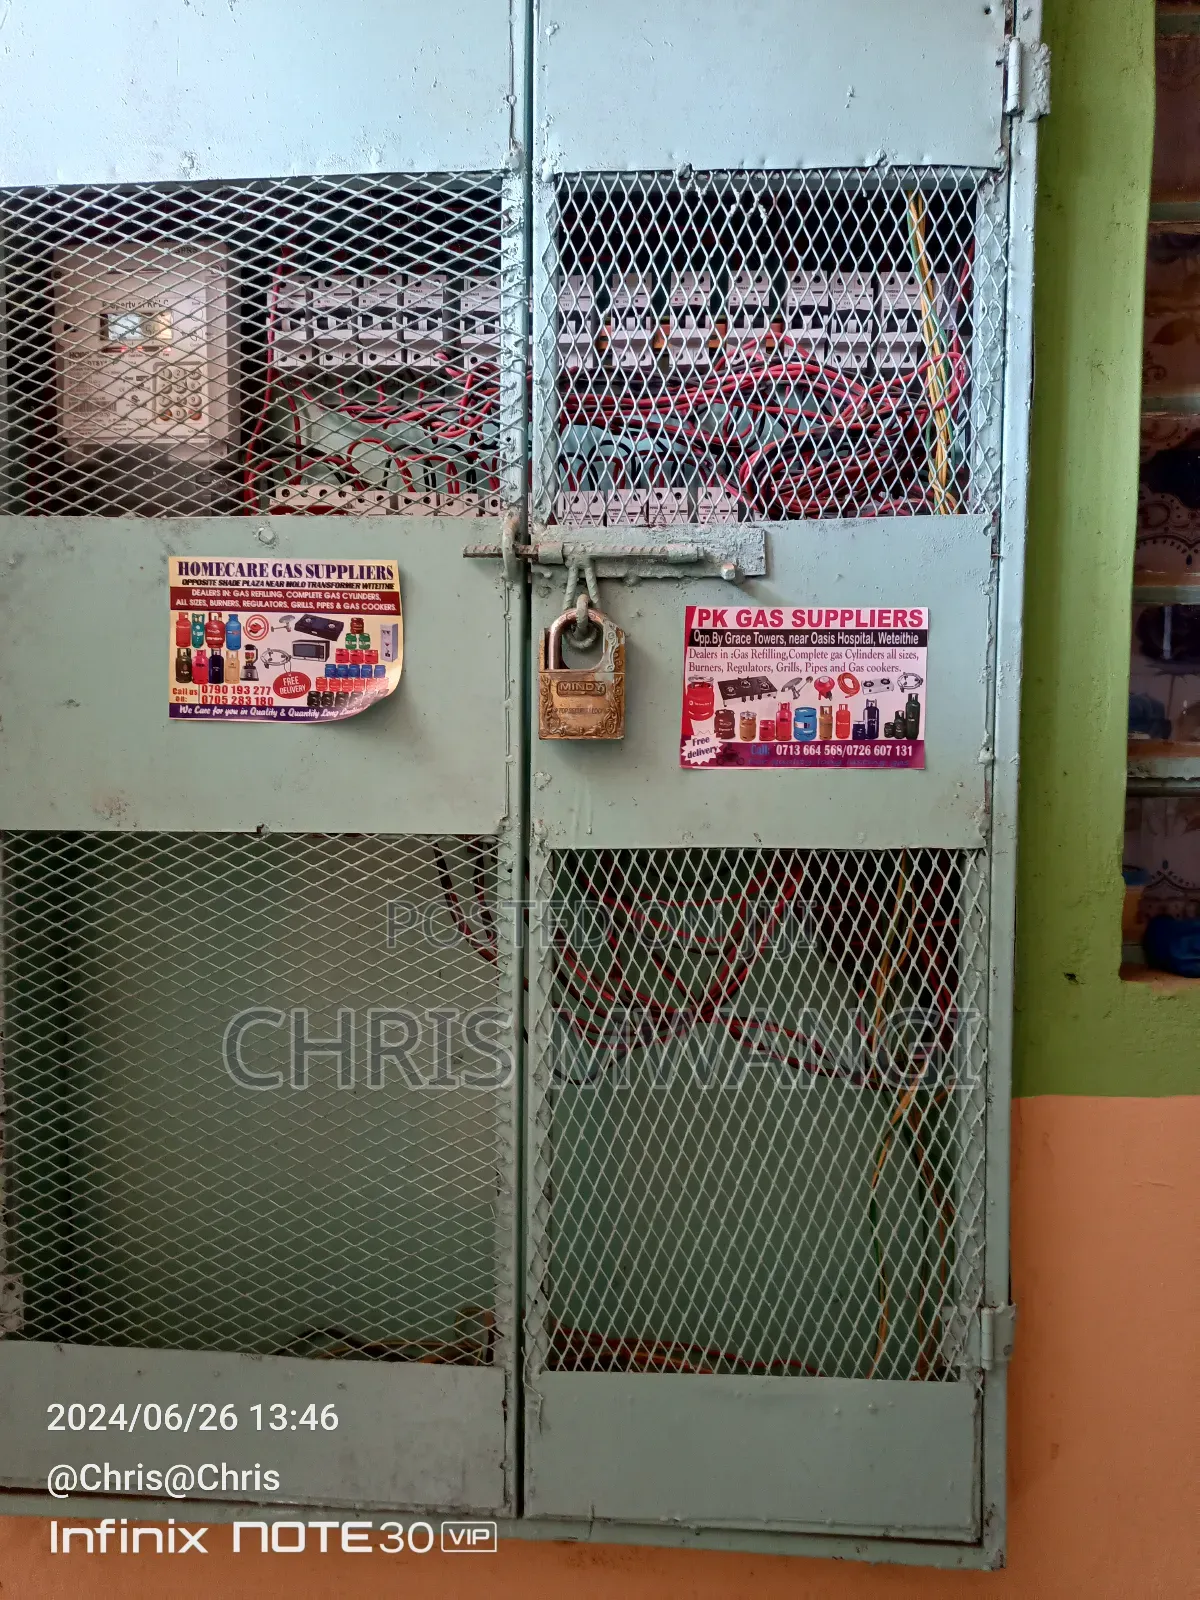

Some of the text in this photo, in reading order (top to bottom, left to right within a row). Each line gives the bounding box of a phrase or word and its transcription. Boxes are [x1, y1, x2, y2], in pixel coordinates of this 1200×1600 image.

[178, 561, 394, 581] HOMECARE GAS SUPPLIERS
[219, 579, 241, 587] SHADE
[265, 580, 284, 588] NEAR
[192, 589, 221, 597] DEALERS
[286, 591, 323, 599] COMPLETE
[342, 592, 382, 601] CYLINDERS,
[698, 609, 924, 628] PK GAS SUPPLIERS
[725, 632, 751, 645] Grace
[753, 632, 787, 646] Towers,
[788, 634, 808, 645] near
[810, 632, 836, 645] Oasis
[837, 631, 876, 647] Hospital,
[878, 632, 919, 645] Weteithie
[689, 649, 718, 659] Dealers
[720, 649, 729, 659] in
[830, 651, 843, 661] gas
[845, 649, 885, 661] Cylinders
[886, 649, 897, 660] all
[898, 650, 919, 661] sizes,
[688, 661, 902, 674] Burners, Regulators, Grills, Pipes and Gas cookers.
[283, 676, 299, 686] FREE
[172, 687, 188, 696] Call
[201, 684, 272, 696] 0790 193 277
[280, 684, 306, 694] DELIVERY
[201, 695, 274, 707] 0705 283 180
[180, 705, 192, 714] We
[194, 705, 211, 714] Care
[212, 705, 223, 716] for
[225, 707, 238, 717] you
[240, 706, 248, 715] in
[250, 706, 278, 718] Quality
[279, 707, 286, 717] &
[288, 708, 320, 719] Quantity
[692, 737, 710, 746] Free
[687, 746, 718, 758] delivery
[776, 744, 800, 756] 0713
[803, 745, 821, 756] 664
[873, 744, 892, 756] 607
[895, 744, 913, 756] 131
